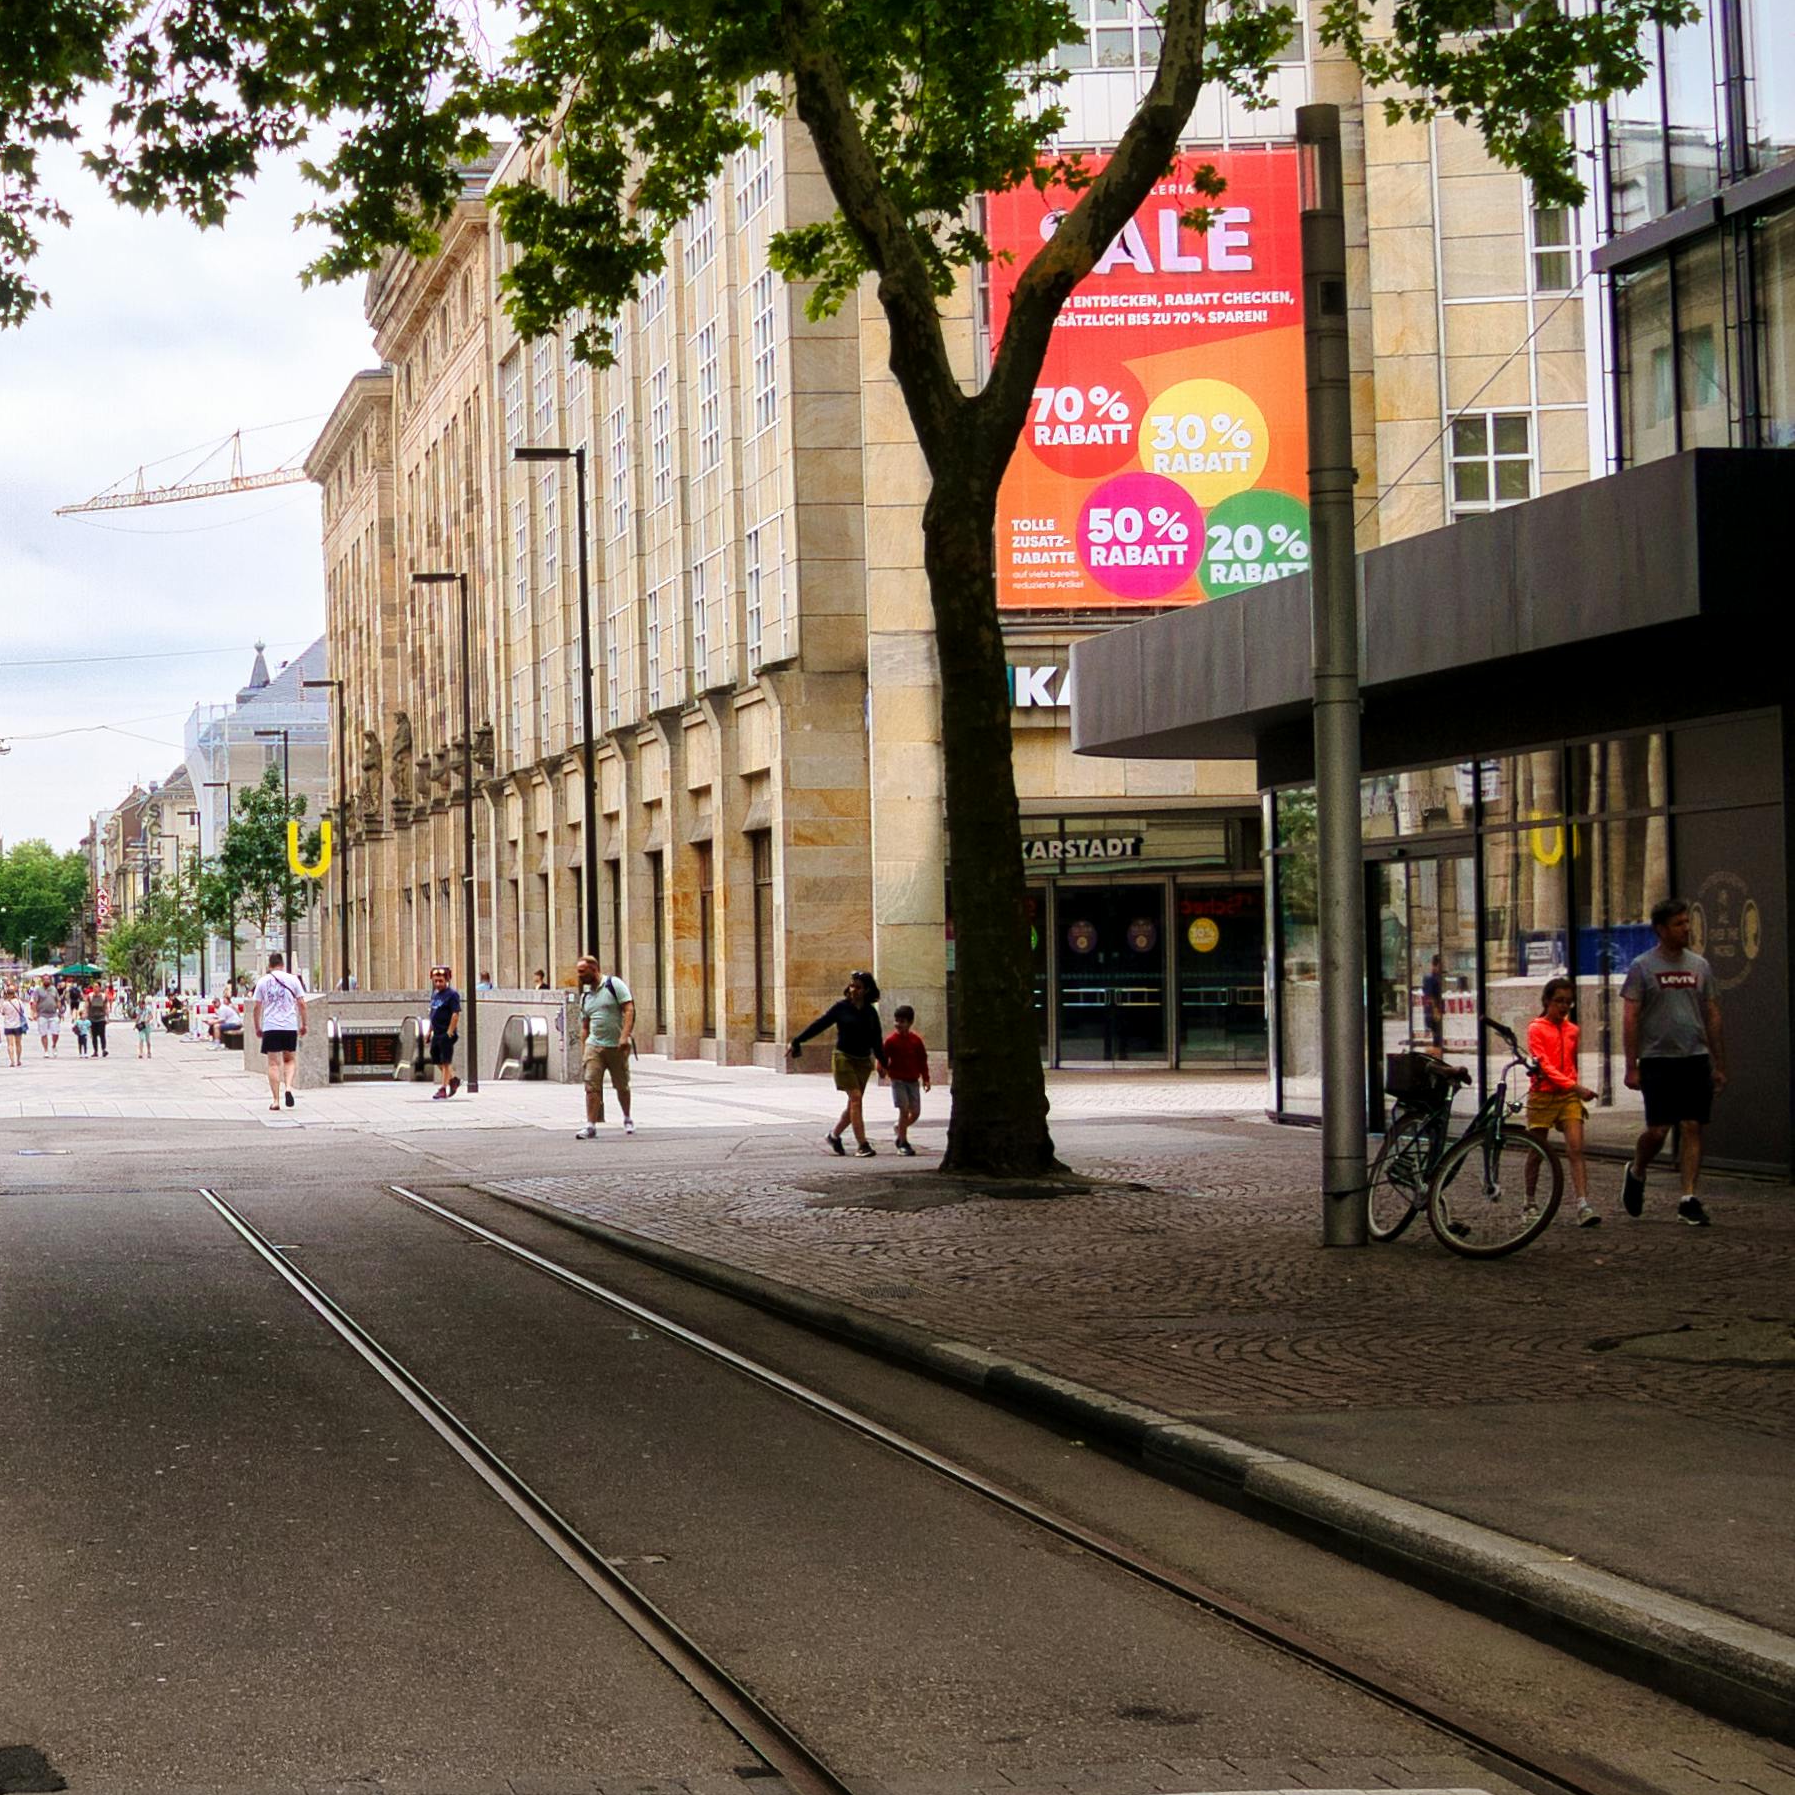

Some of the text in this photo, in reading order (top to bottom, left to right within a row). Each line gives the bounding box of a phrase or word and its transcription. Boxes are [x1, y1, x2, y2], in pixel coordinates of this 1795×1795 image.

[1149, 184, 1195, 196] LERIA
[1073, 294, 1162, 308] ENTDECKEN,
[1164, 293, 1220, 306] RABATT
[1222, 291, 1295, 305] CHECKEN,
[1053, 312, 1125, 327] SÄTZLICH
[1127, 313, 1150, 325] BIS
[1152, 312, 1171, 325] ZU
[1208, 310, 1268, 324] SPAREN!
[1034, 423, 1133, 446] RABATT
[1153, 451, 1252, 474] RABATT
[1011, 518, 1055, 532] TOLLE
[1011, 535, 1071, 548] ZUSATZ-
[1012, 551, 1076, 565] RABATTE
[1090, 544, 1189, 567] RABATT
[287, 820, 332, 878] U
